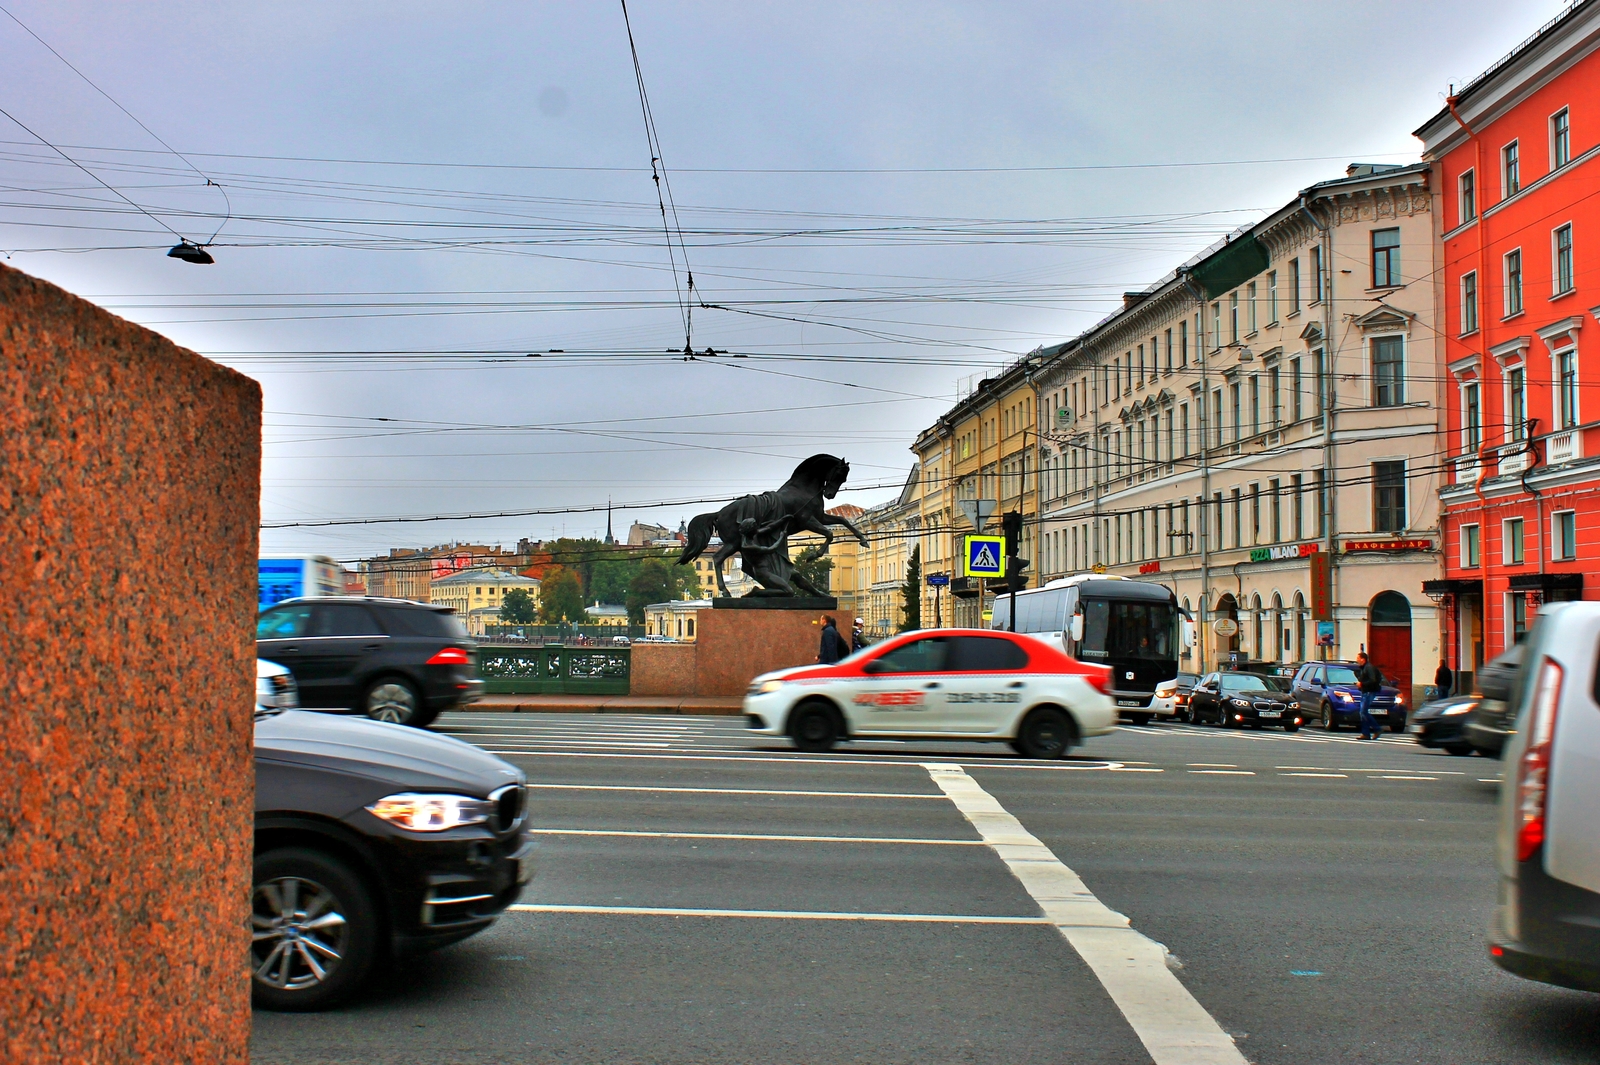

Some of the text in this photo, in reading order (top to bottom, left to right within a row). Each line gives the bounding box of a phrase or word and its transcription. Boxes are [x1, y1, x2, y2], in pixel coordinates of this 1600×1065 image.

[1250, 543, 1318, 562] PIZZA MILANO BAR
